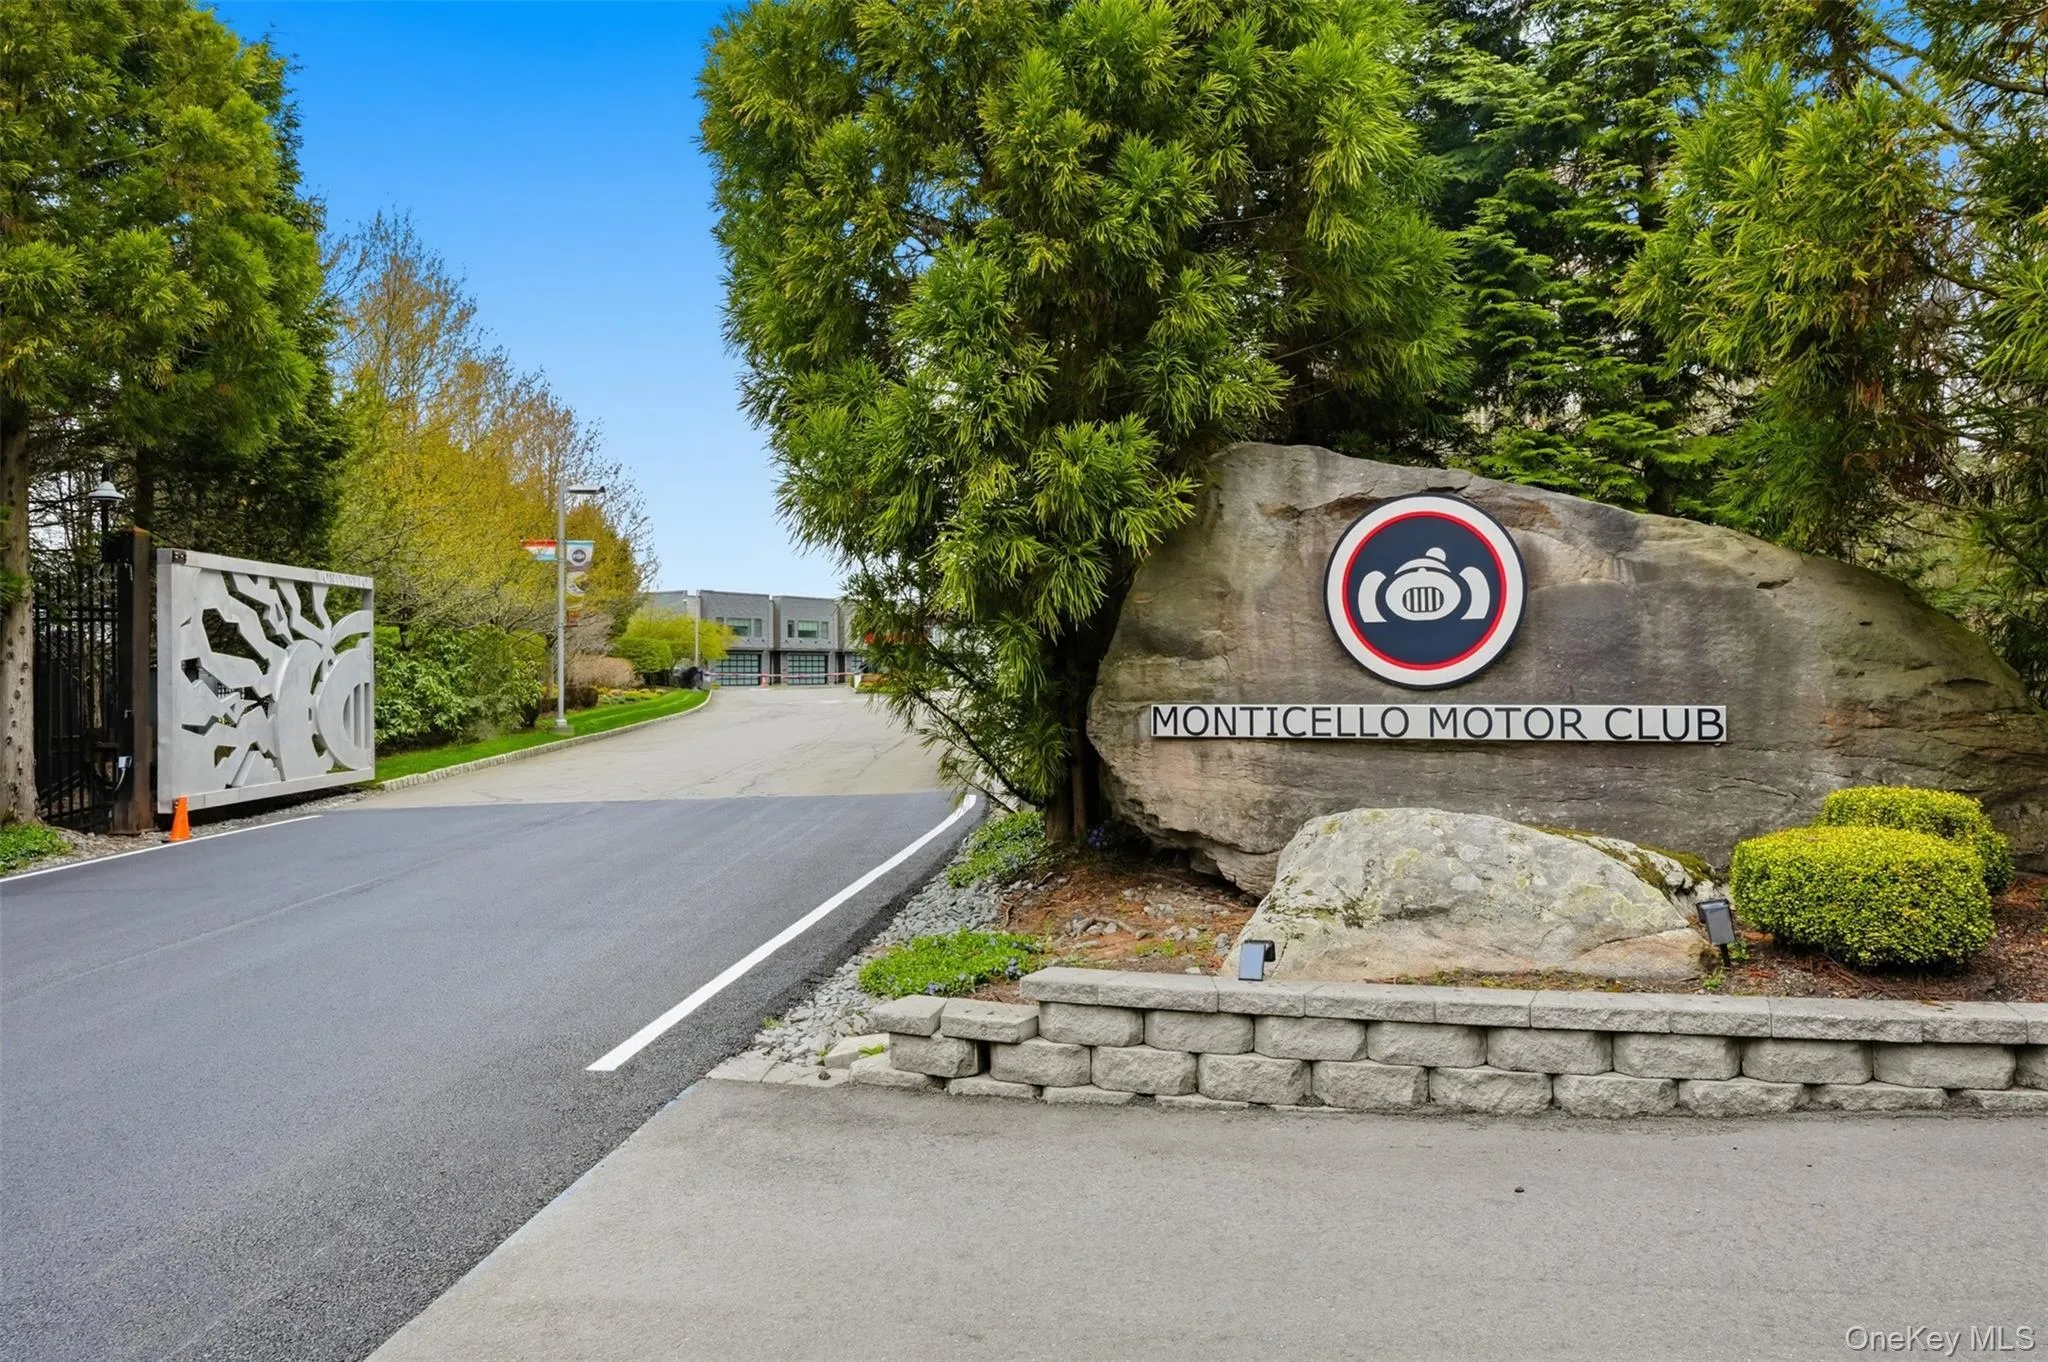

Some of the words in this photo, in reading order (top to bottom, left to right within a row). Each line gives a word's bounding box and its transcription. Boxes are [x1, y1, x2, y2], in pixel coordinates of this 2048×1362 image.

[1152, 706, 1410, 738] MONTICELLO
[1429, 706, 1588, 740] MOTOR
[1604, 707, 1725, 741] CLUB
